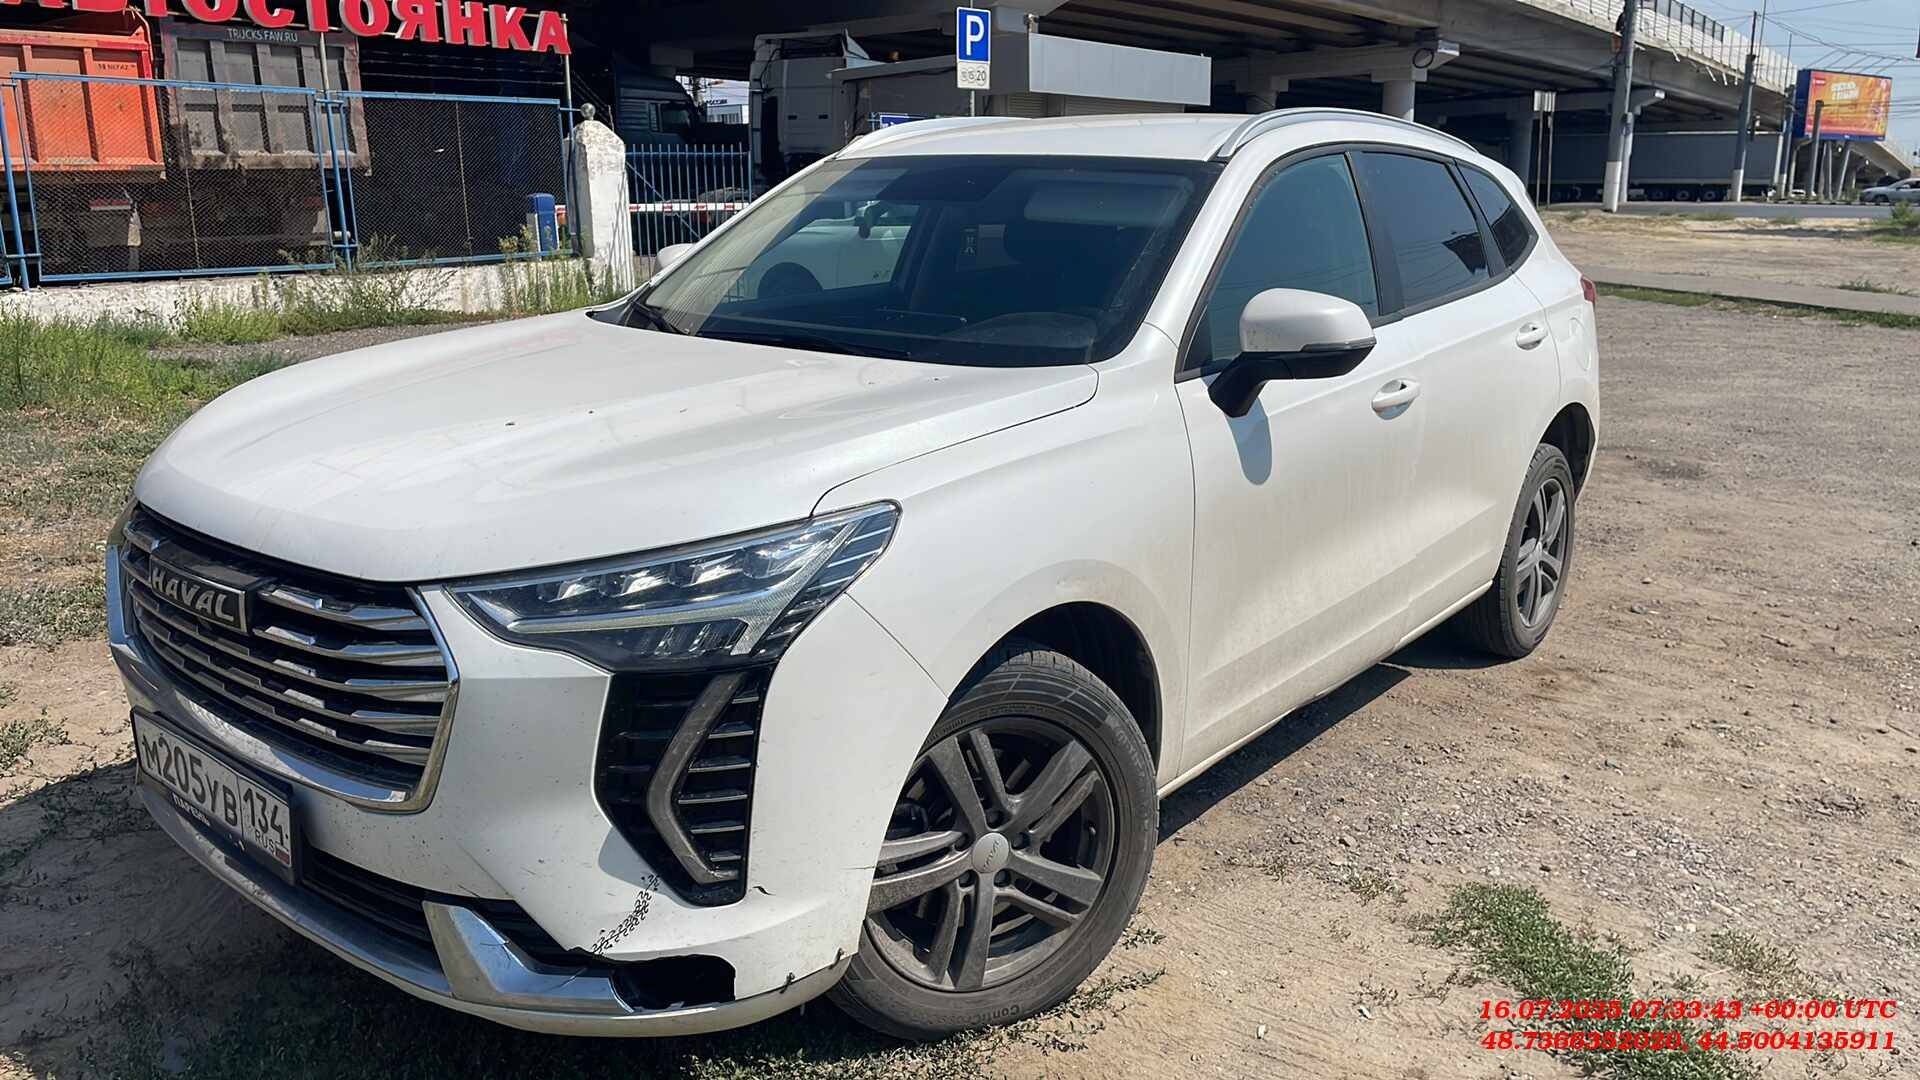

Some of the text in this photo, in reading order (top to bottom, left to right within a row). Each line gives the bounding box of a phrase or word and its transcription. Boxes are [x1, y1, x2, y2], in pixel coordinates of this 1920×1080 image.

[966, 15, 985, 56] P
[151, 567, 235, 622] HAVAL
[243, 788, 284, 846] 134
